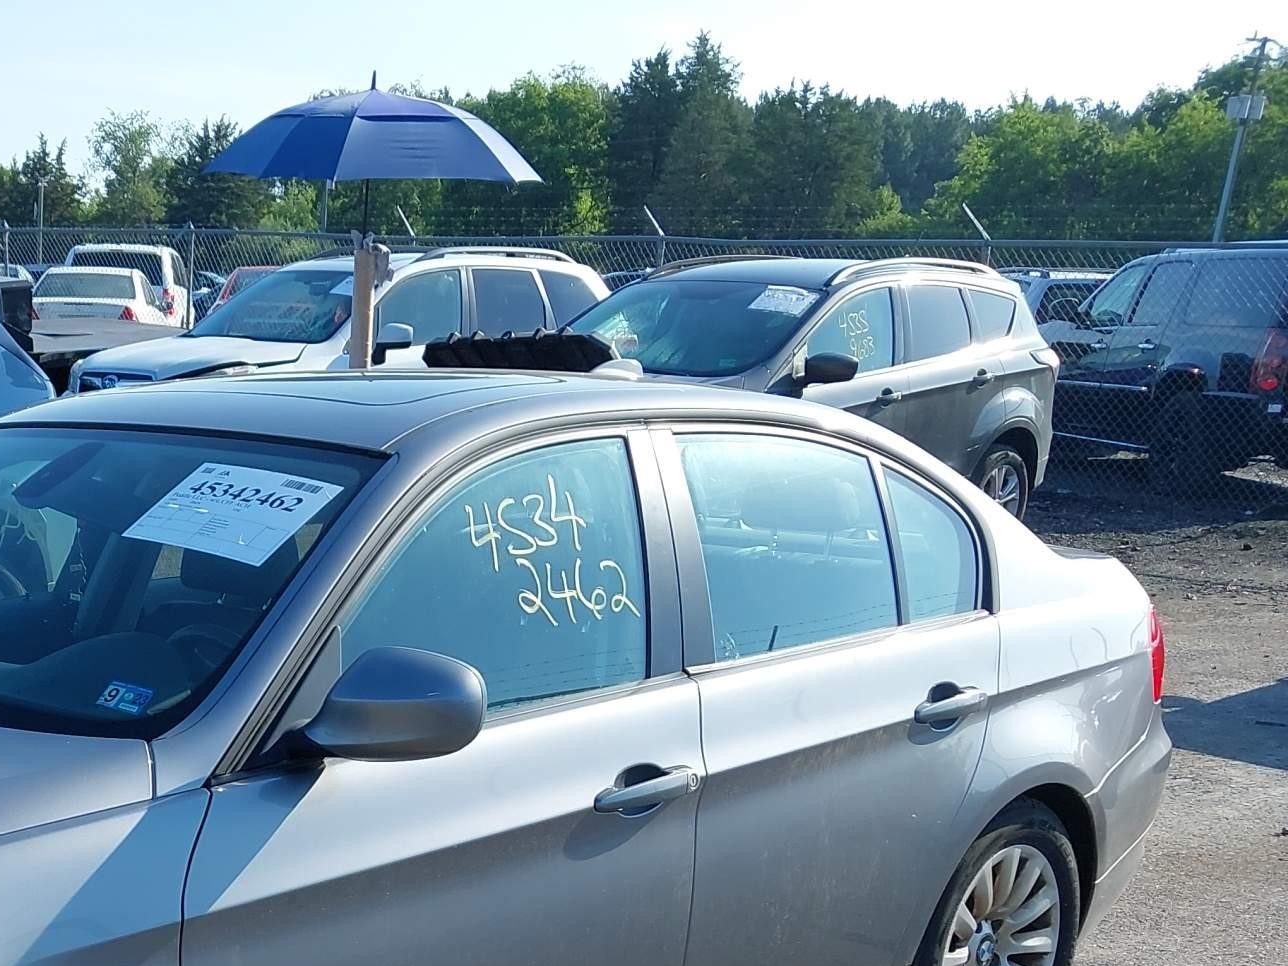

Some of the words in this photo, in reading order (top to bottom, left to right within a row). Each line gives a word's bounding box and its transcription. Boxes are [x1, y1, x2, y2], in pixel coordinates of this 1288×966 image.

[188, 479, 305, 513] 45342462
[464, 472, 588, 573] 4534
[515, 557, 641, 627] 2462
[103, 687, 121, 703] 9
